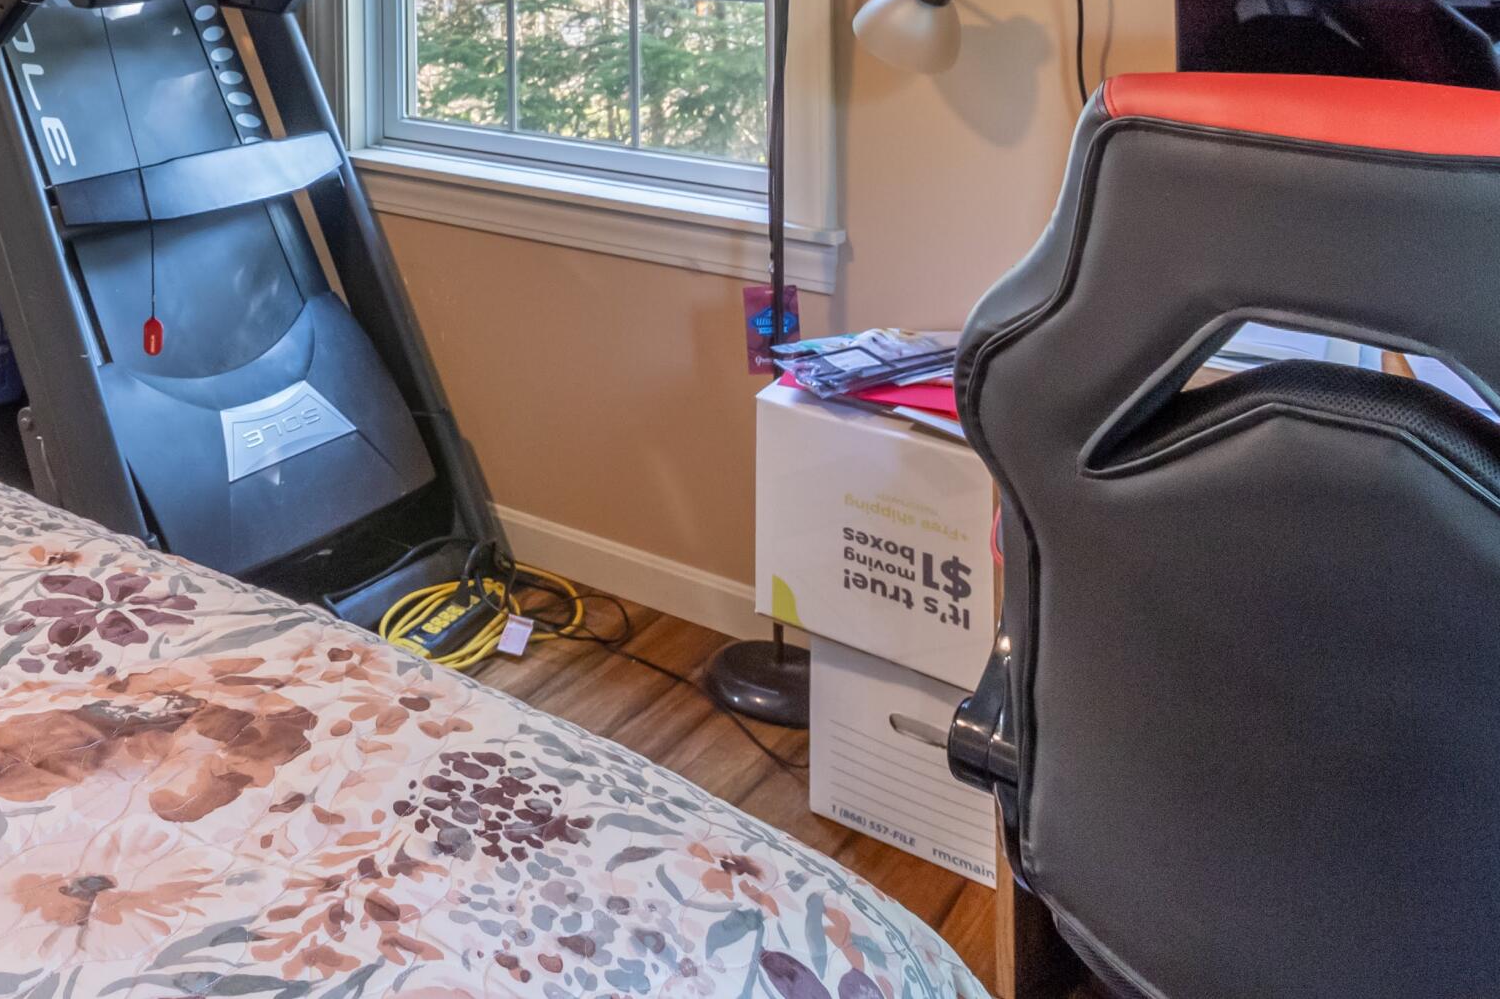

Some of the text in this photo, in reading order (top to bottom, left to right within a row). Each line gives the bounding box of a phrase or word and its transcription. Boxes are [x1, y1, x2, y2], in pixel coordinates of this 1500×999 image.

[243, 407, 321, 448] SOLE
[844, 492, 917, 525] shipping
[842, 527, 915, 566] boxes
[843, 546, 916, 582] moving
[922, 551, 972, 603] $1
[843, 568, 971, 630] It's true!
[869, 820, 916, 848] 557-FILE
